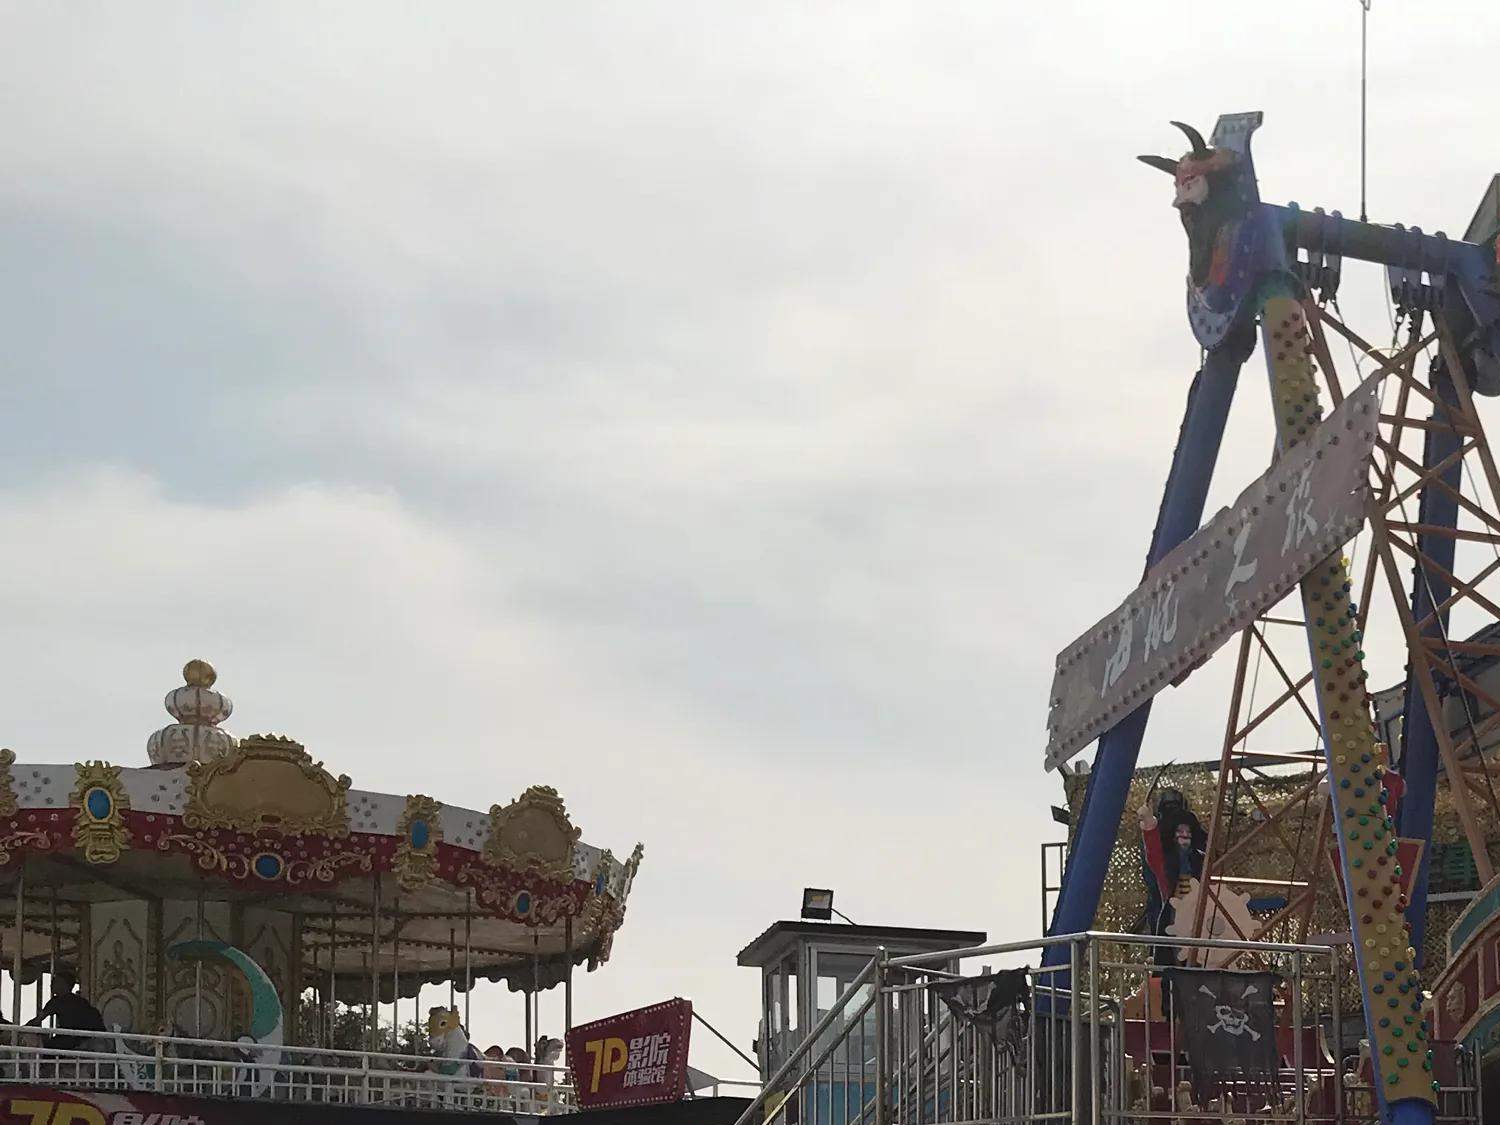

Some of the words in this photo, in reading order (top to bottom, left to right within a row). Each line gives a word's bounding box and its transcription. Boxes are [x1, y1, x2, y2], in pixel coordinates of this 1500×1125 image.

[584, 1037, 628, 1093] 7D
[628, 1032, 671, 1069] 影院
[623, 1065, 667, 1088] 体验馆
